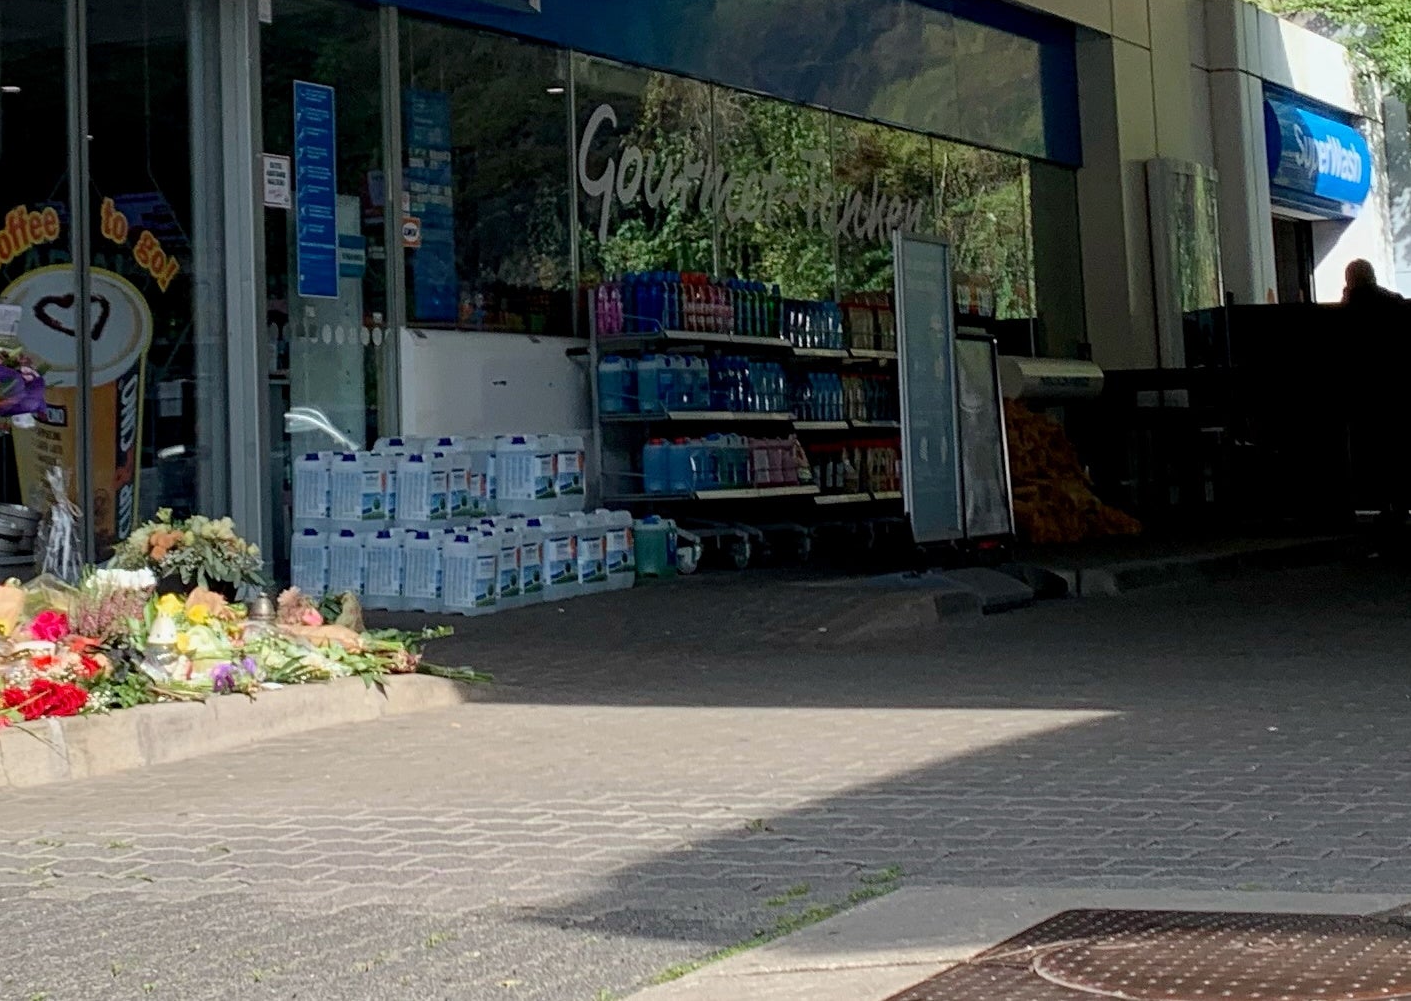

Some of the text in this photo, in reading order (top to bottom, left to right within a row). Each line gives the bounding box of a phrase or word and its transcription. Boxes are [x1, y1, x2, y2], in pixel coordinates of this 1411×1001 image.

[1293, 123, 1363, 185] SuperWash
[101, 196, 128, 244] to
[133, 230, 180, 292] go!
